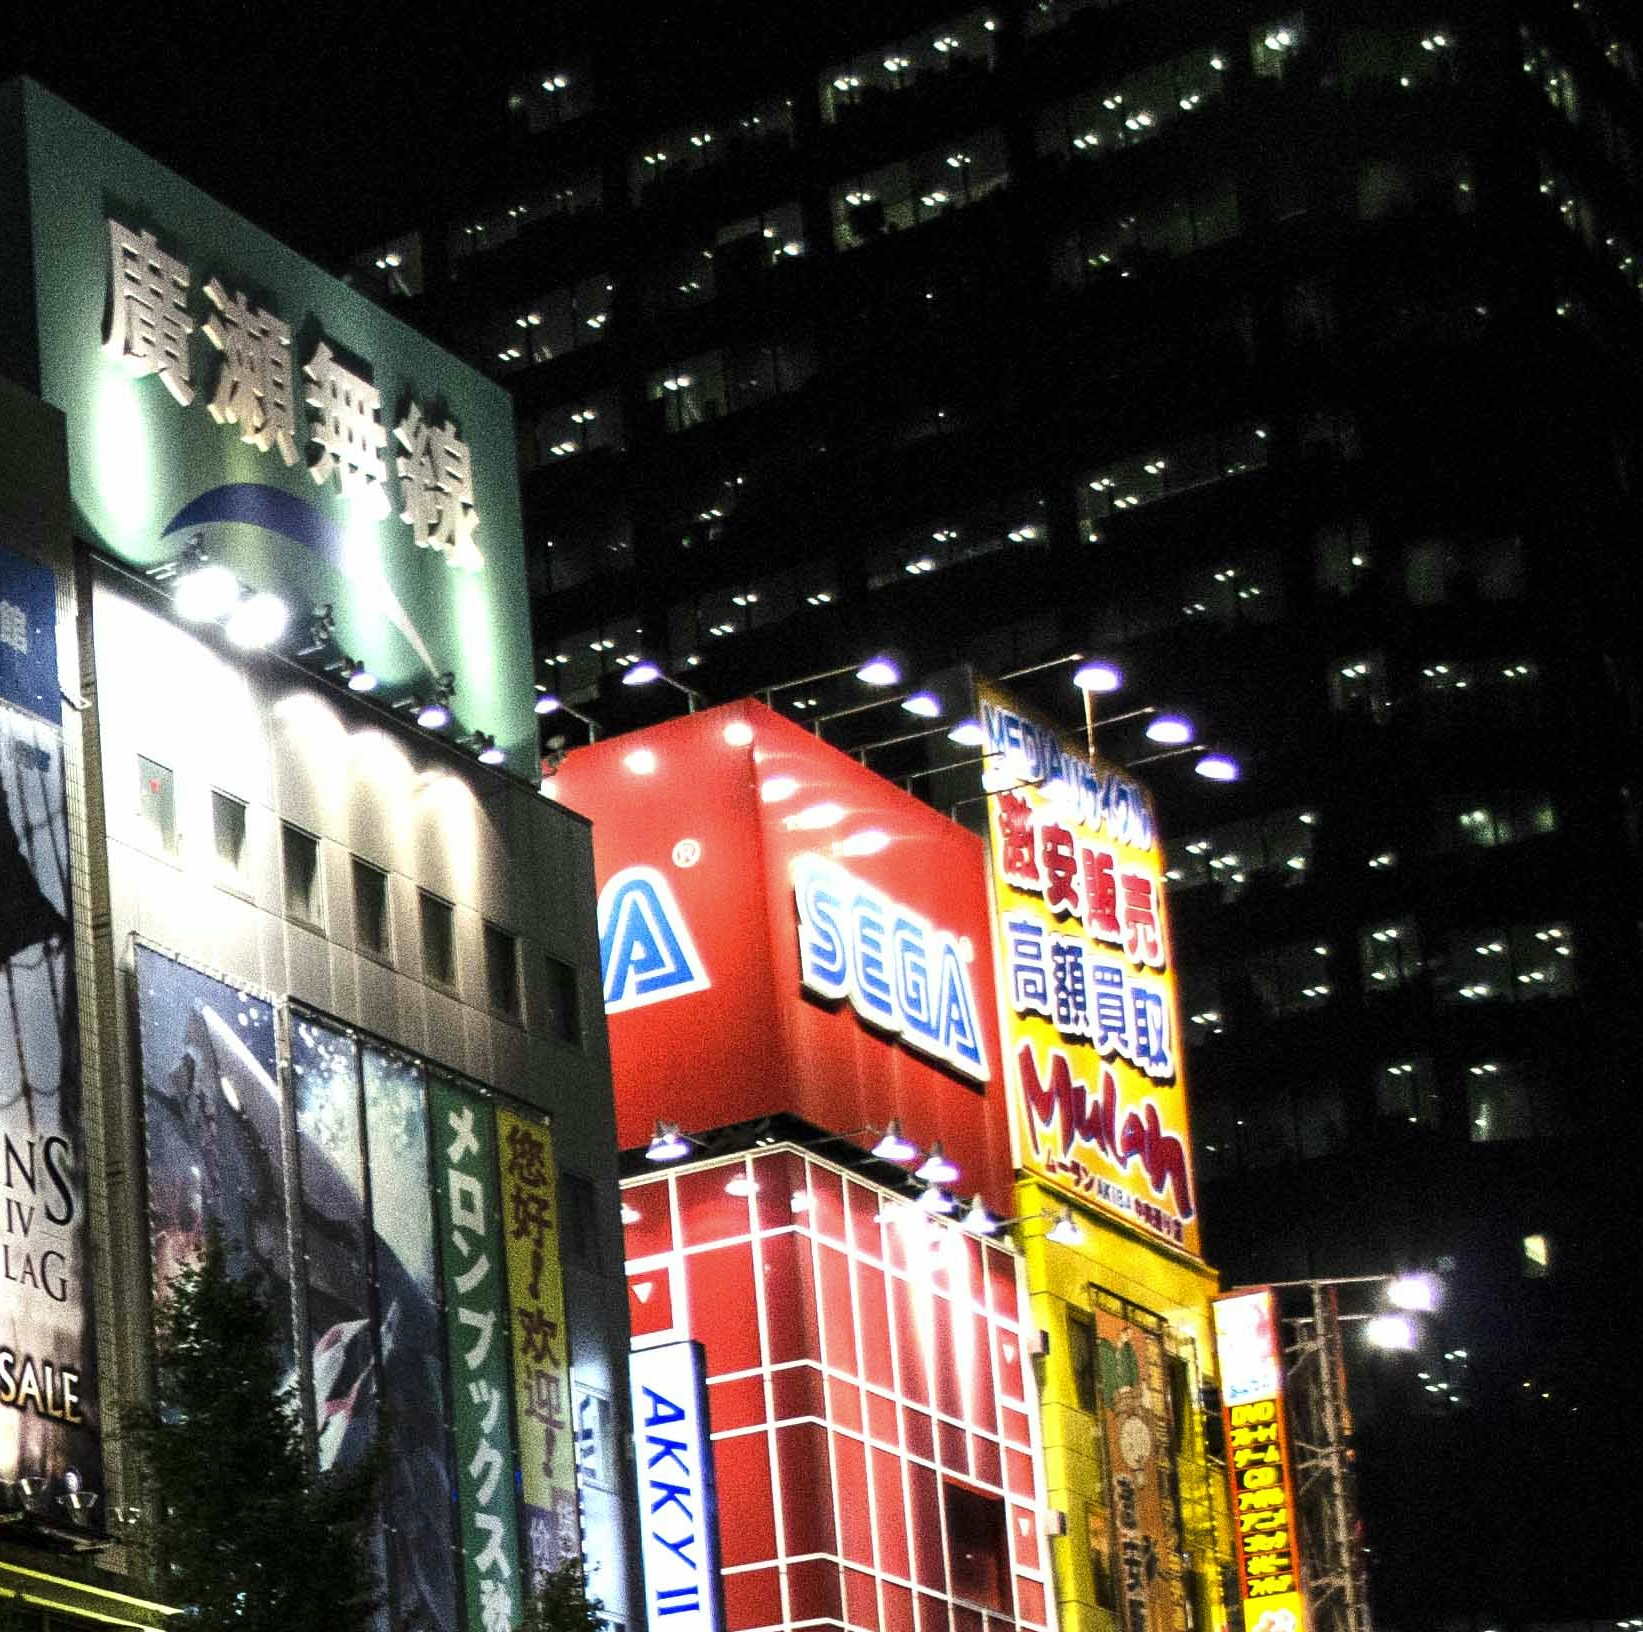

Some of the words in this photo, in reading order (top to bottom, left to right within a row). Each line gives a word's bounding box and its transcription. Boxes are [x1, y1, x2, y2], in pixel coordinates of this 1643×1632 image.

[795, 853, 990, 1083] SEGA
[1005, 912, 1174, 1079] 高額買取
[6, 1199, 36, 1240] IV
